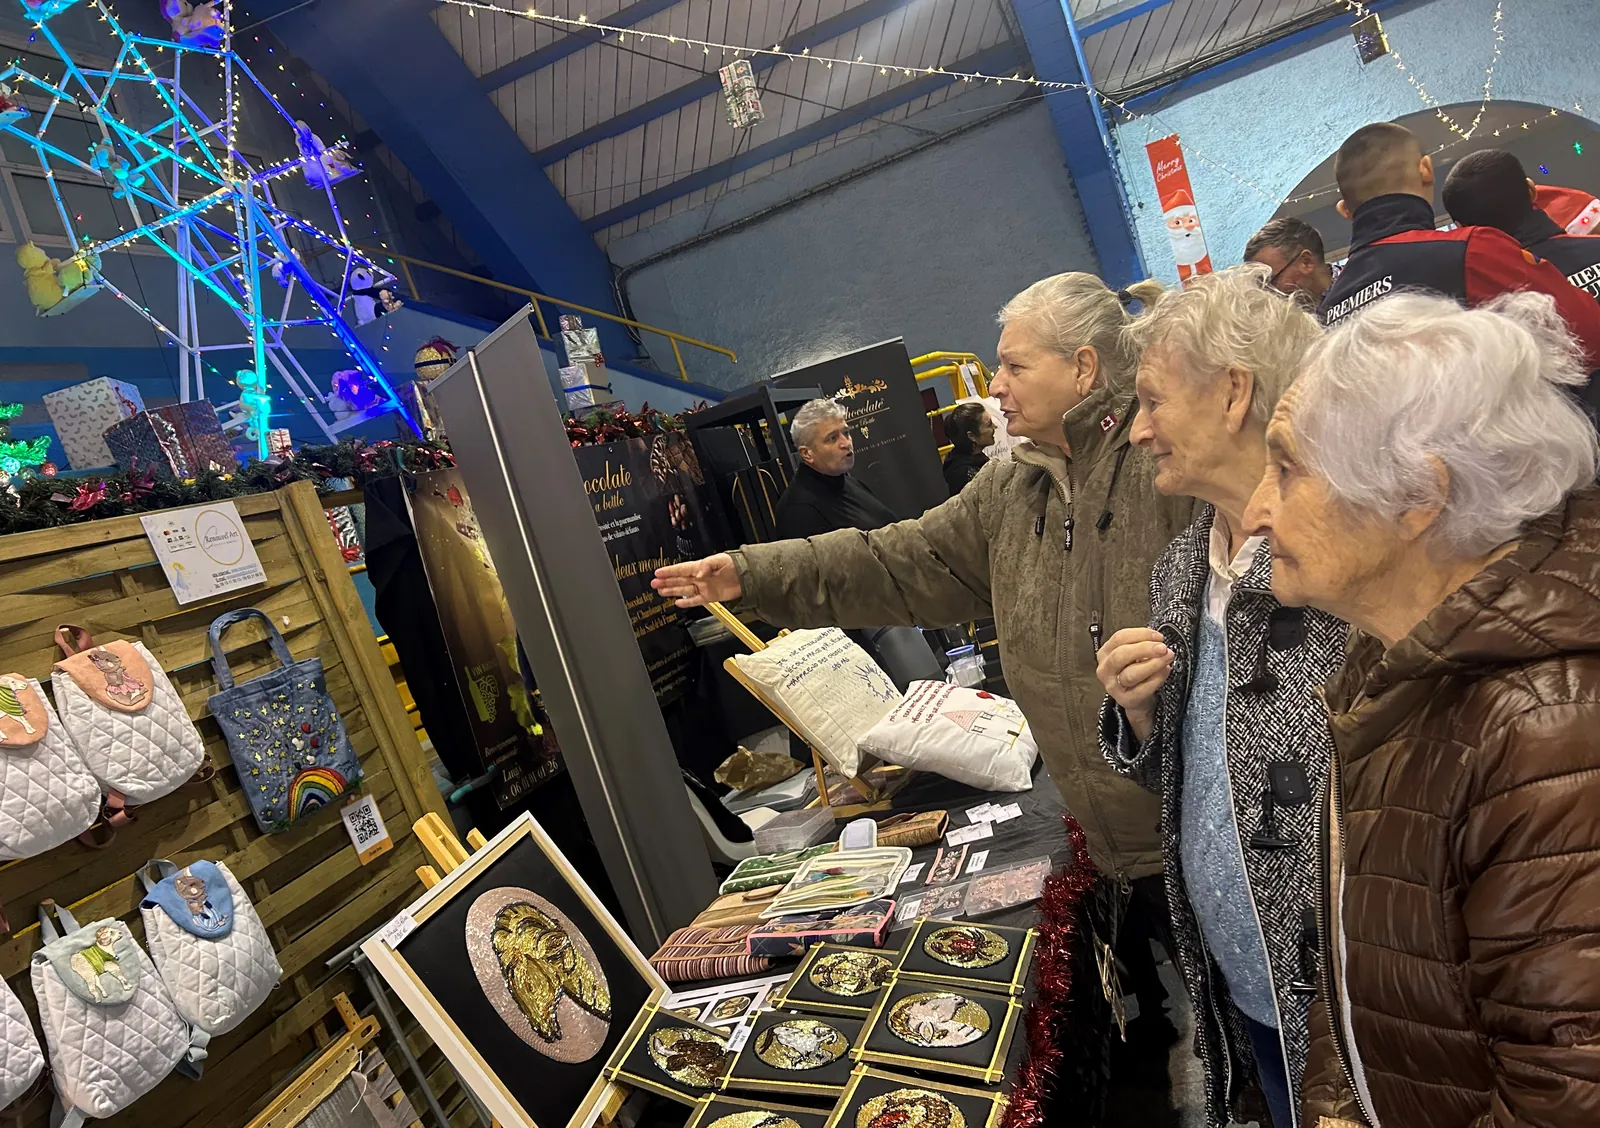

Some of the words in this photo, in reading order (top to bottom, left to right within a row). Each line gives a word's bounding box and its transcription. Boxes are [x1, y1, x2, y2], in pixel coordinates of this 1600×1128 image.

[1156, 157, 1180, 175] Merry
[1156, 164, 1183, 183] Christmas
[1326, 275, 1392, 325] PREMIERS
[845, 399, 885, 420] hocolate
[583, 460, 633, 495] ocolate
[594, 503, 601, 513] a
[603, 490, 625, 511] bottle
[615, 554, 637, 580] deux
[510, 781, 522, 797] 06
[547, 757, 559, 773] 26
